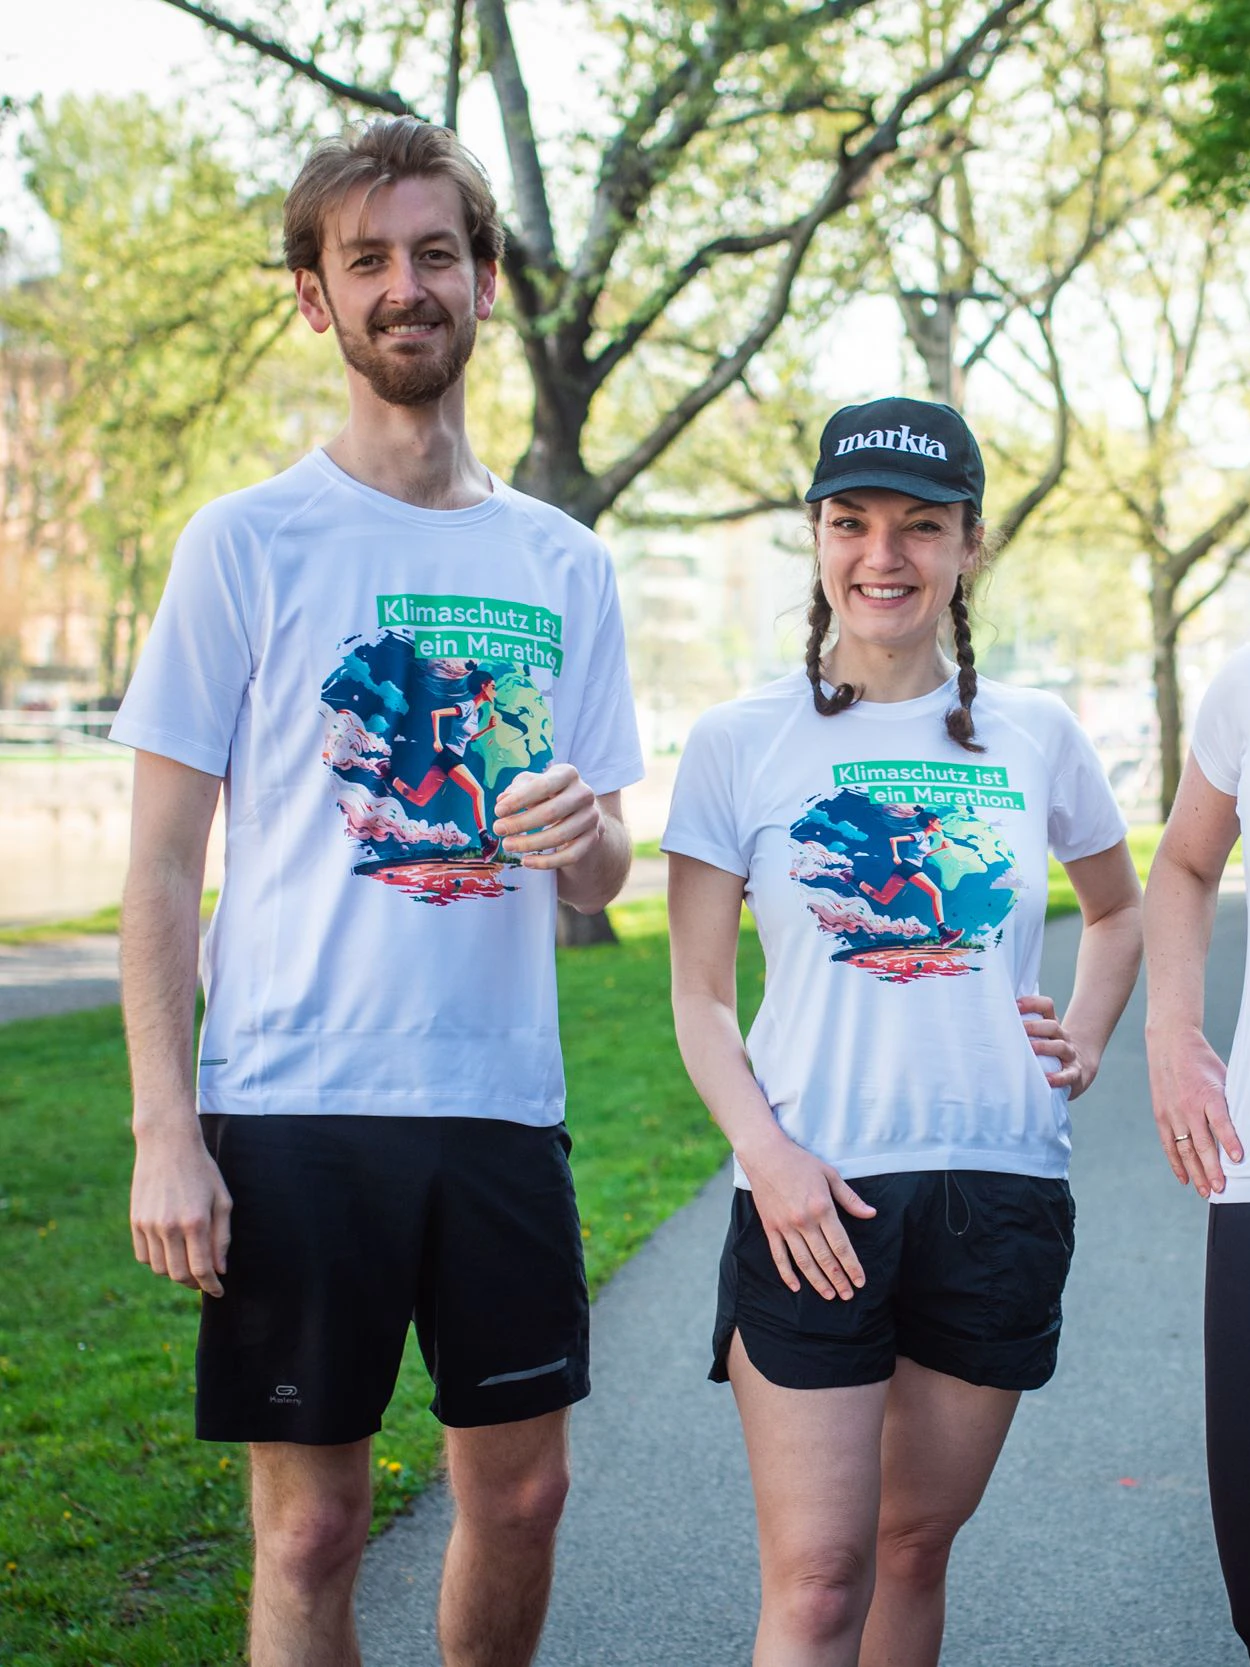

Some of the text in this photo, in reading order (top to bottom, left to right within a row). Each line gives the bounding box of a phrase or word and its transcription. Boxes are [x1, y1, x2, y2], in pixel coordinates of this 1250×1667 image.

[834, 424, 948, 461] markta
[384, 598, 529, 631] Klimaschutz
[419, 633, 458, 656] ein
[839, 764, 1004, 786] Klimaschutz ist
[874, 786, 1021, 809] ein Marathon.
